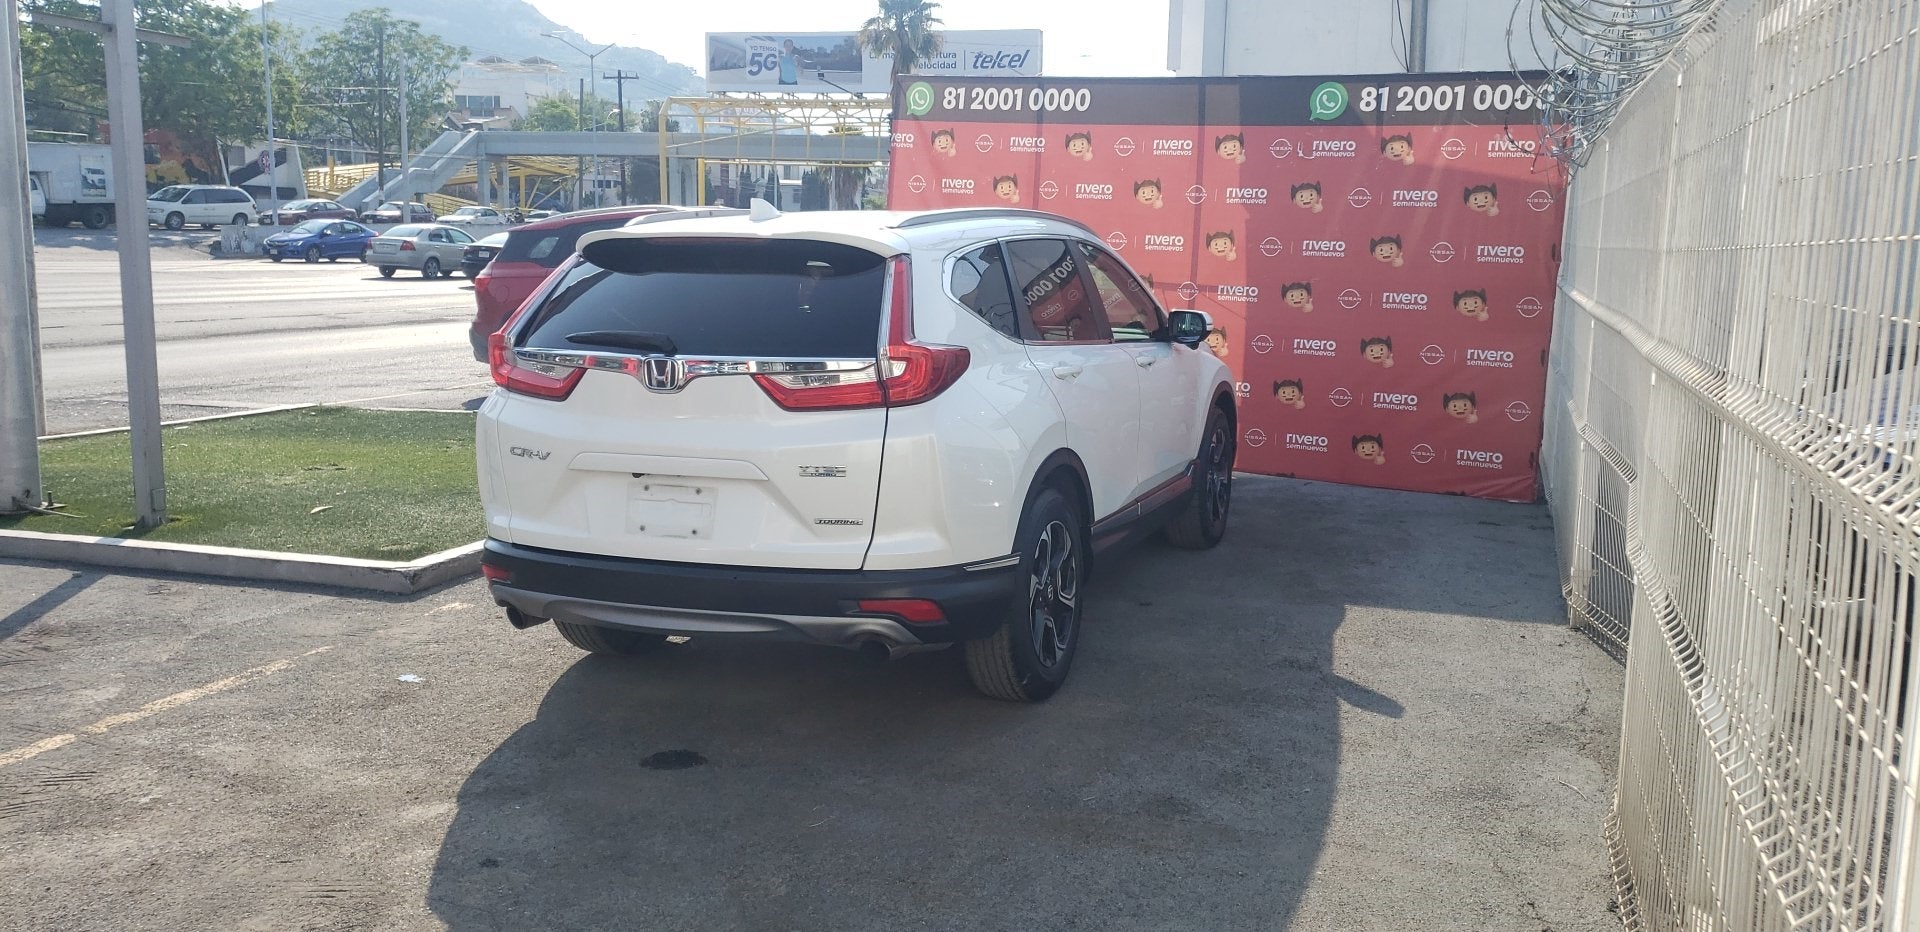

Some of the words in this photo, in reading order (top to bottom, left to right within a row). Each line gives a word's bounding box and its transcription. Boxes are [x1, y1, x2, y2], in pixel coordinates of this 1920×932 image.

[748, 53, 777, 76] 5G
[973, 49, 1030, 70] telcel
[943, 86, 966, 110] 81
[970, 87, 1023, 111] 2001
[1028, 87, 1091, 112] 0000
[1359, 86, 1390, 112] 81
[1396, 84, 1466, 112] 2001
[1010, 136, 1046, 147] rivero
[1153, 139, 1193, 150] rivero
[1313, 140, 1357, 151] rivero
[1488, 140, 1536, 152] rivero
[942, 178, 975, 189] rivero
[1075, 183, 1113, 194] rivero
[1226, 187, 1268, 198] rivero
[1392, 190, 1438, 201] rivero
[1392, 200, 1437, 208] seminuevos
[1145, 234, 1184, 246] rivero
[1302, 240, 1346, 251] rivero
[1144, 244, 1184, 252] seminuevos
[1476, 245, 1525, 258] rivero
[1302, 250, 1345, 258] seminuevos
[1476, 256, 1524, 264] seminuevos
[1217, 284, 1259, 296] rivero
[1217, 295, 1258, 303] seminuevos
[1382, 291, 1428, 304] rivero
[1382, 302, 1427, 311] seminuevos
[1293, 337, 1337, 351] rivero
[1293, 348, 1336, 357] seminuevos
[1467, 348, 1514, 362] rivero
[1466, 359, 1513, 368] seminuevos
[1373, 391, 1418, 405] rivero
[1373, 402, 1417, 411] seminuevos
[1286, 432, 1329, 447] rivero
[1286, 442, 1328, 453] seminuevos
[510, 446, 551, 461] CR-V
[1456, 448, 1503, 463] rivero
[1456, 459, 1503, 470] seminuevos
